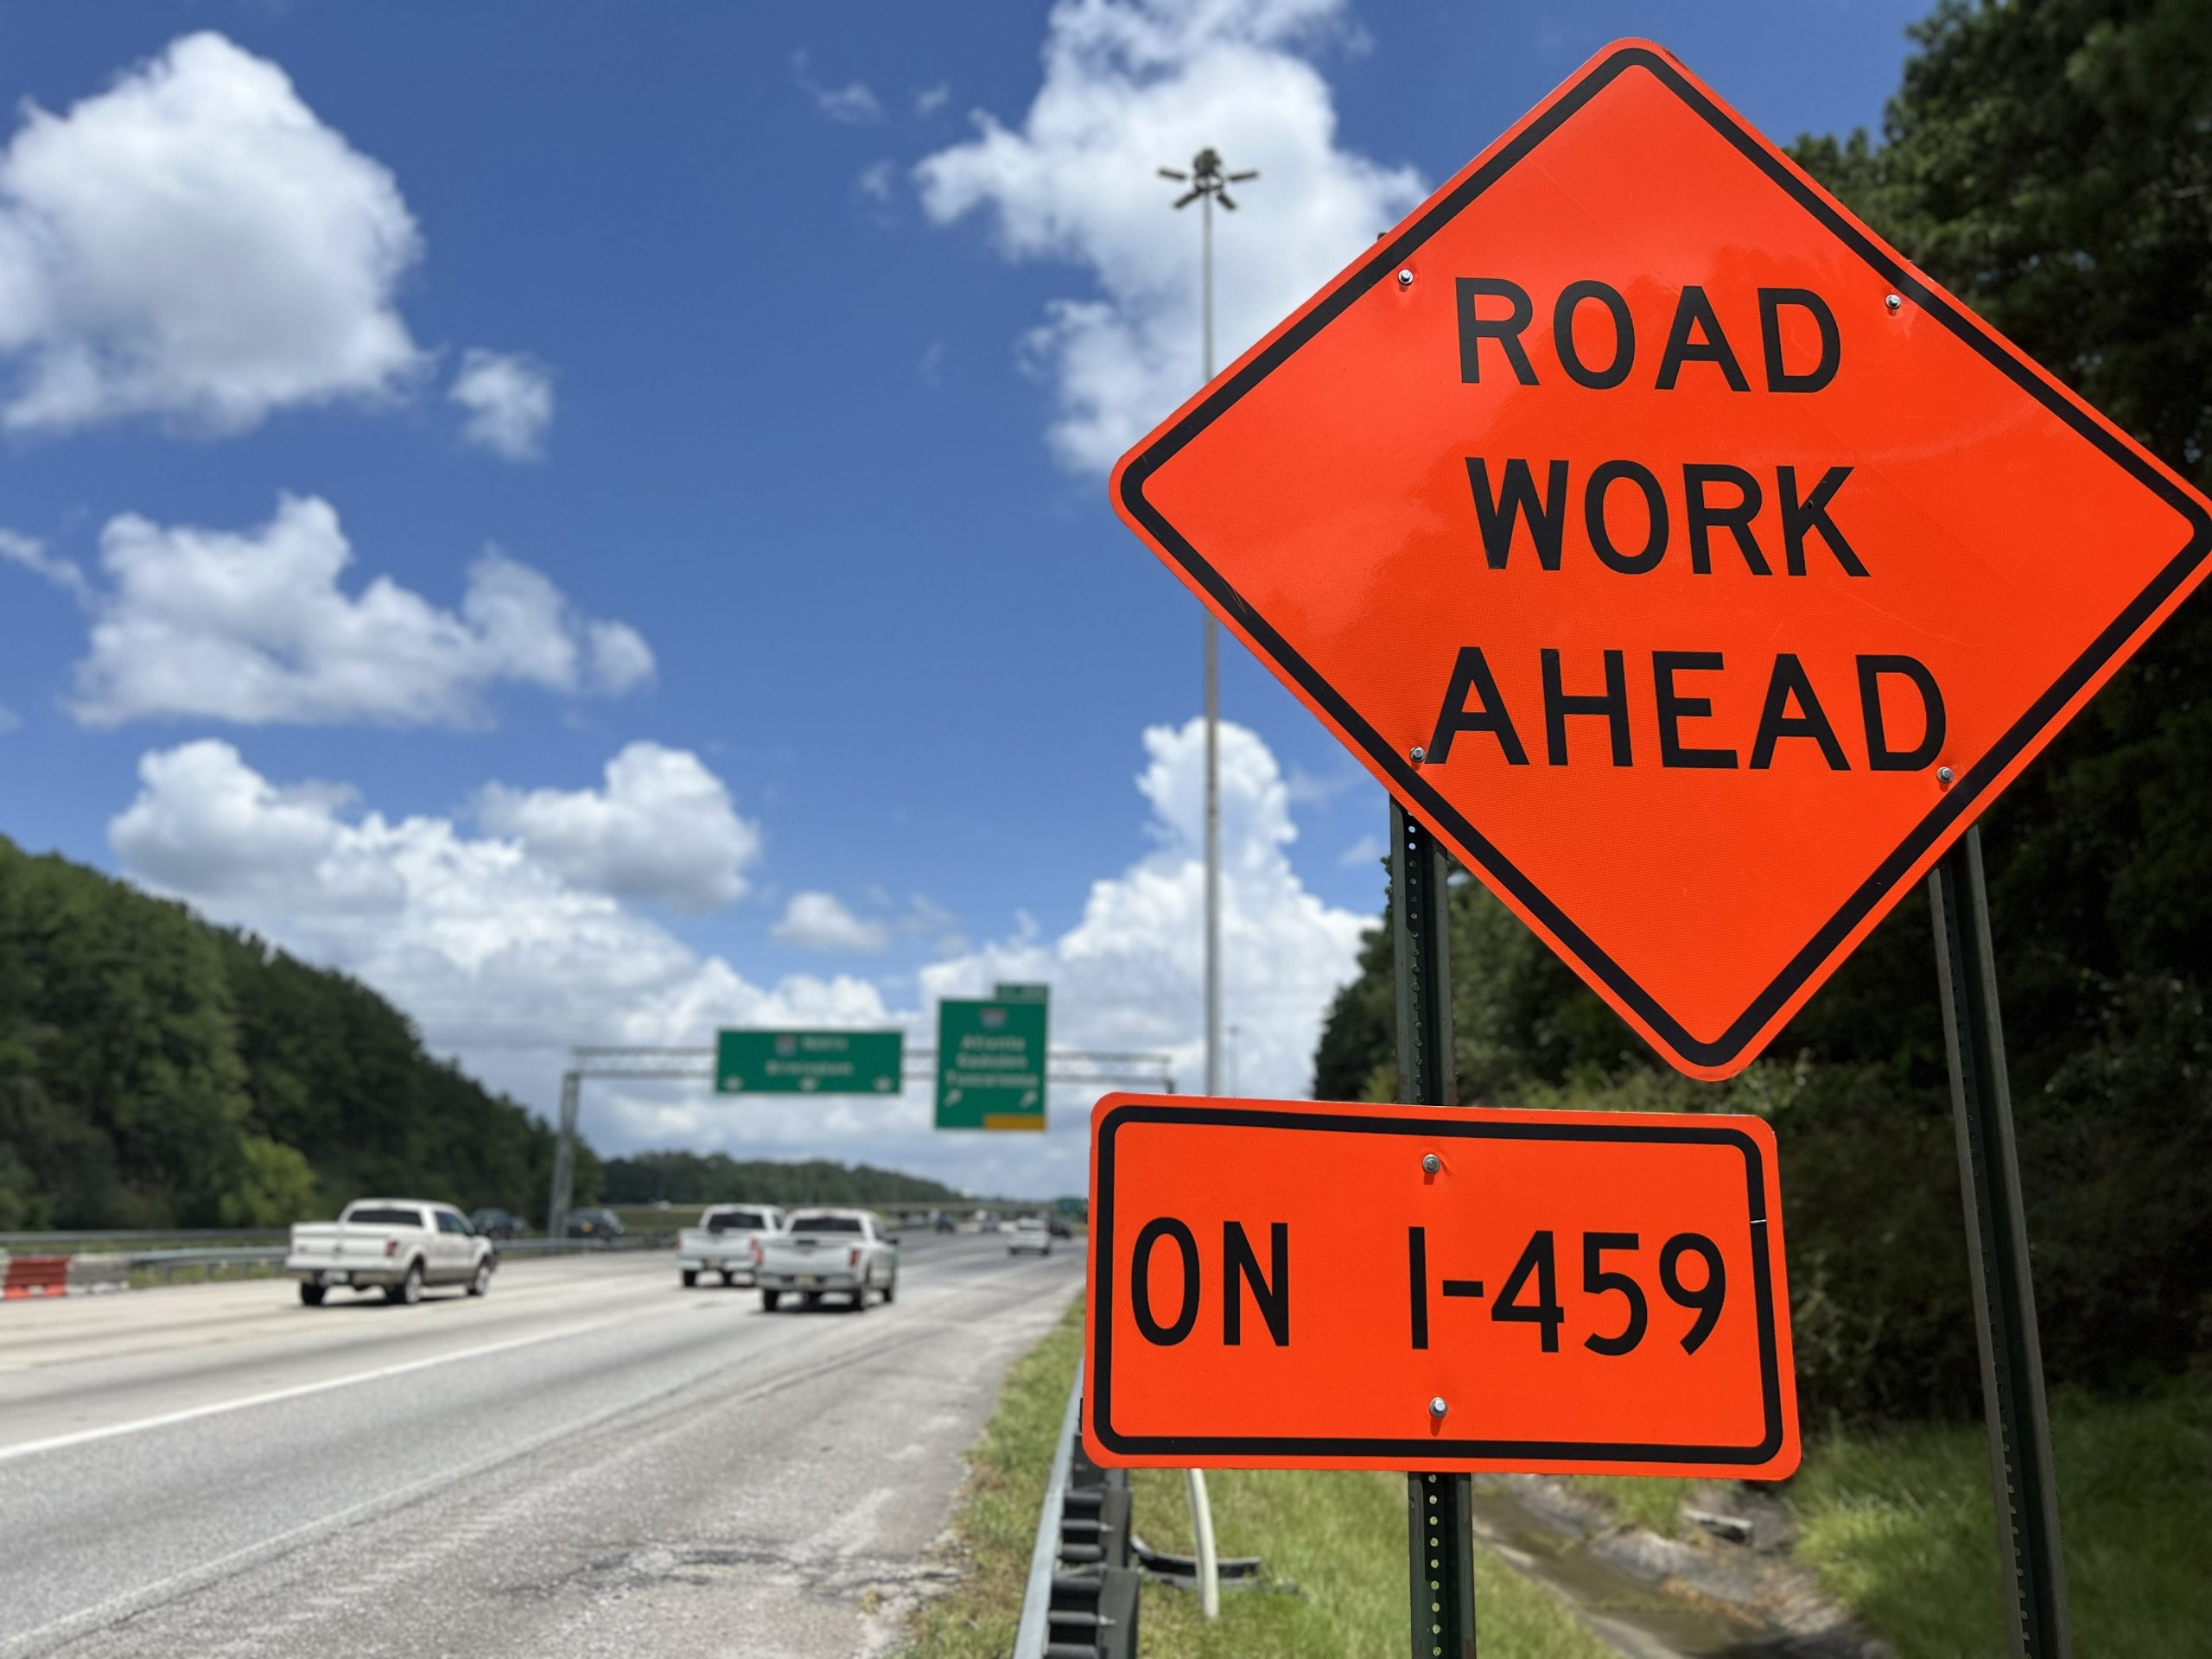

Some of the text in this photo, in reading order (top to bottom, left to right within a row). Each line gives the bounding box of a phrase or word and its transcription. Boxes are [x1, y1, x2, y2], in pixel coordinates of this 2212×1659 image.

[1455, 276, 1841, 393] ROAD
[1465, 456, 1871, 577] WORK
[1426, 645, 1947, 772] AHEAD
[1130, 1217, 1726, 1357] ON I-459
